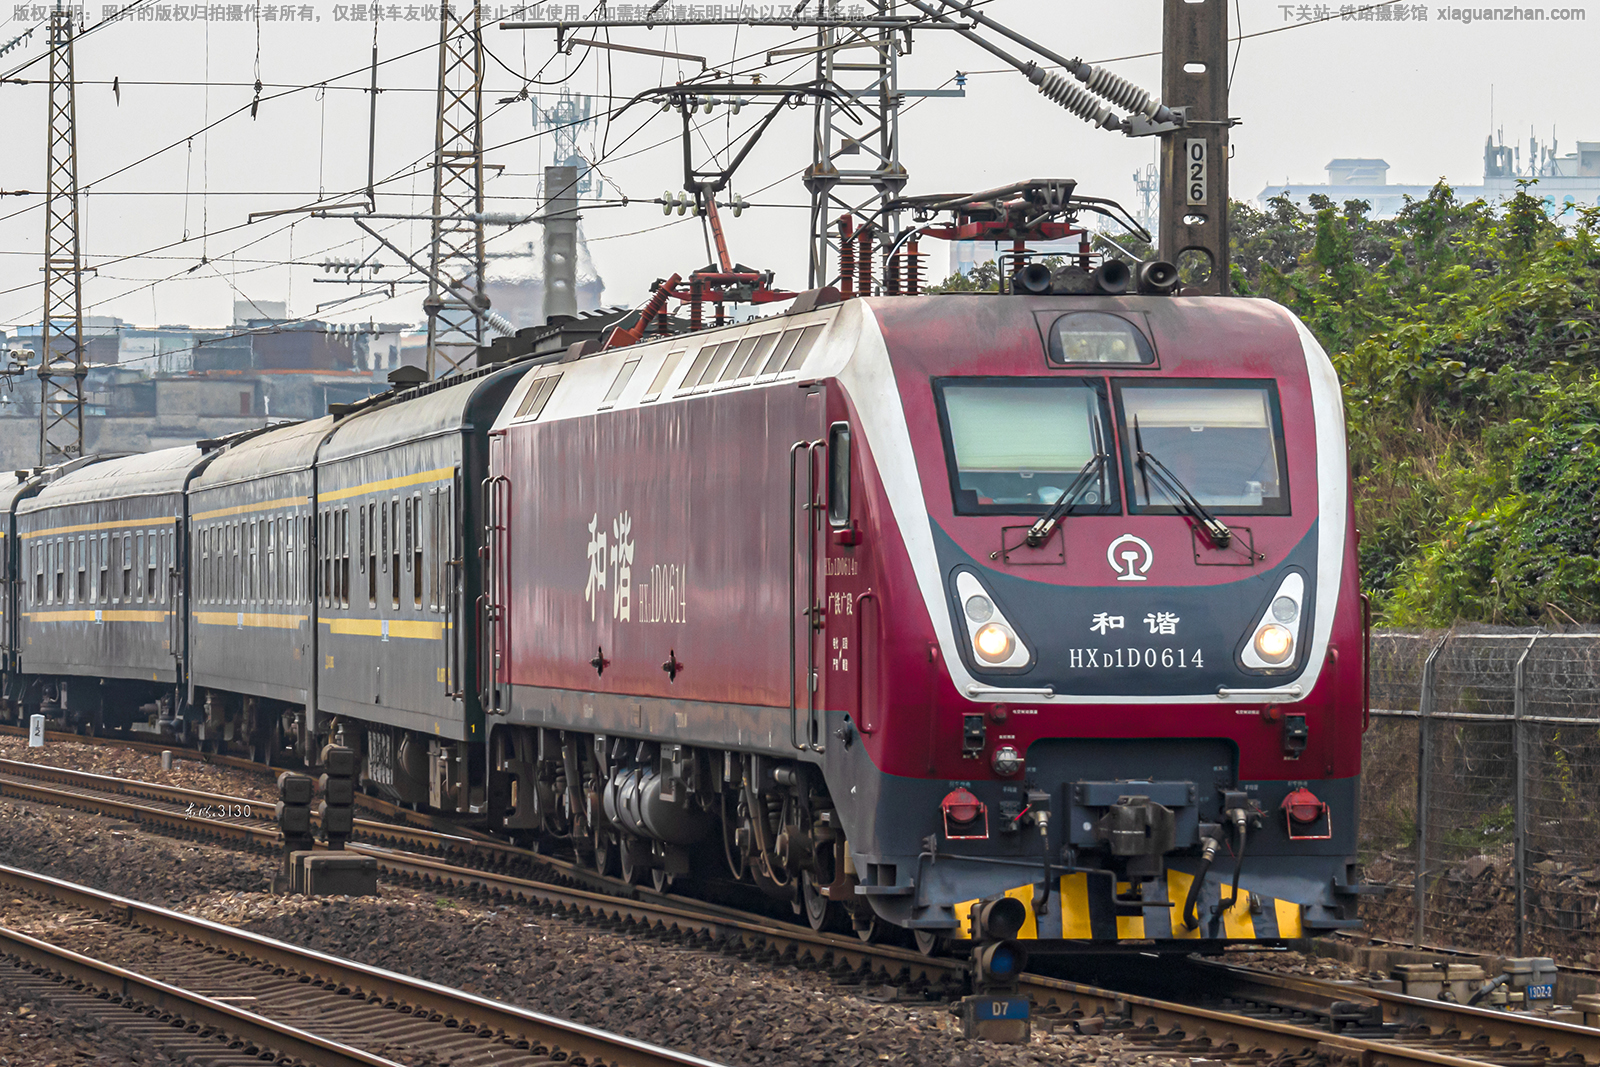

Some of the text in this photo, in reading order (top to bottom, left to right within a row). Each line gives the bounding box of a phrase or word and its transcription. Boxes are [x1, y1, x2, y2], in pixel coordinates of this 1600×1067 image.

[1190, 143, 1204, 201] 026
[585, 510, 635, 622] 和谐
[1069, 647, 1204, 668] HXD1D0614
[992, 1001, 1009, 1016] D7
